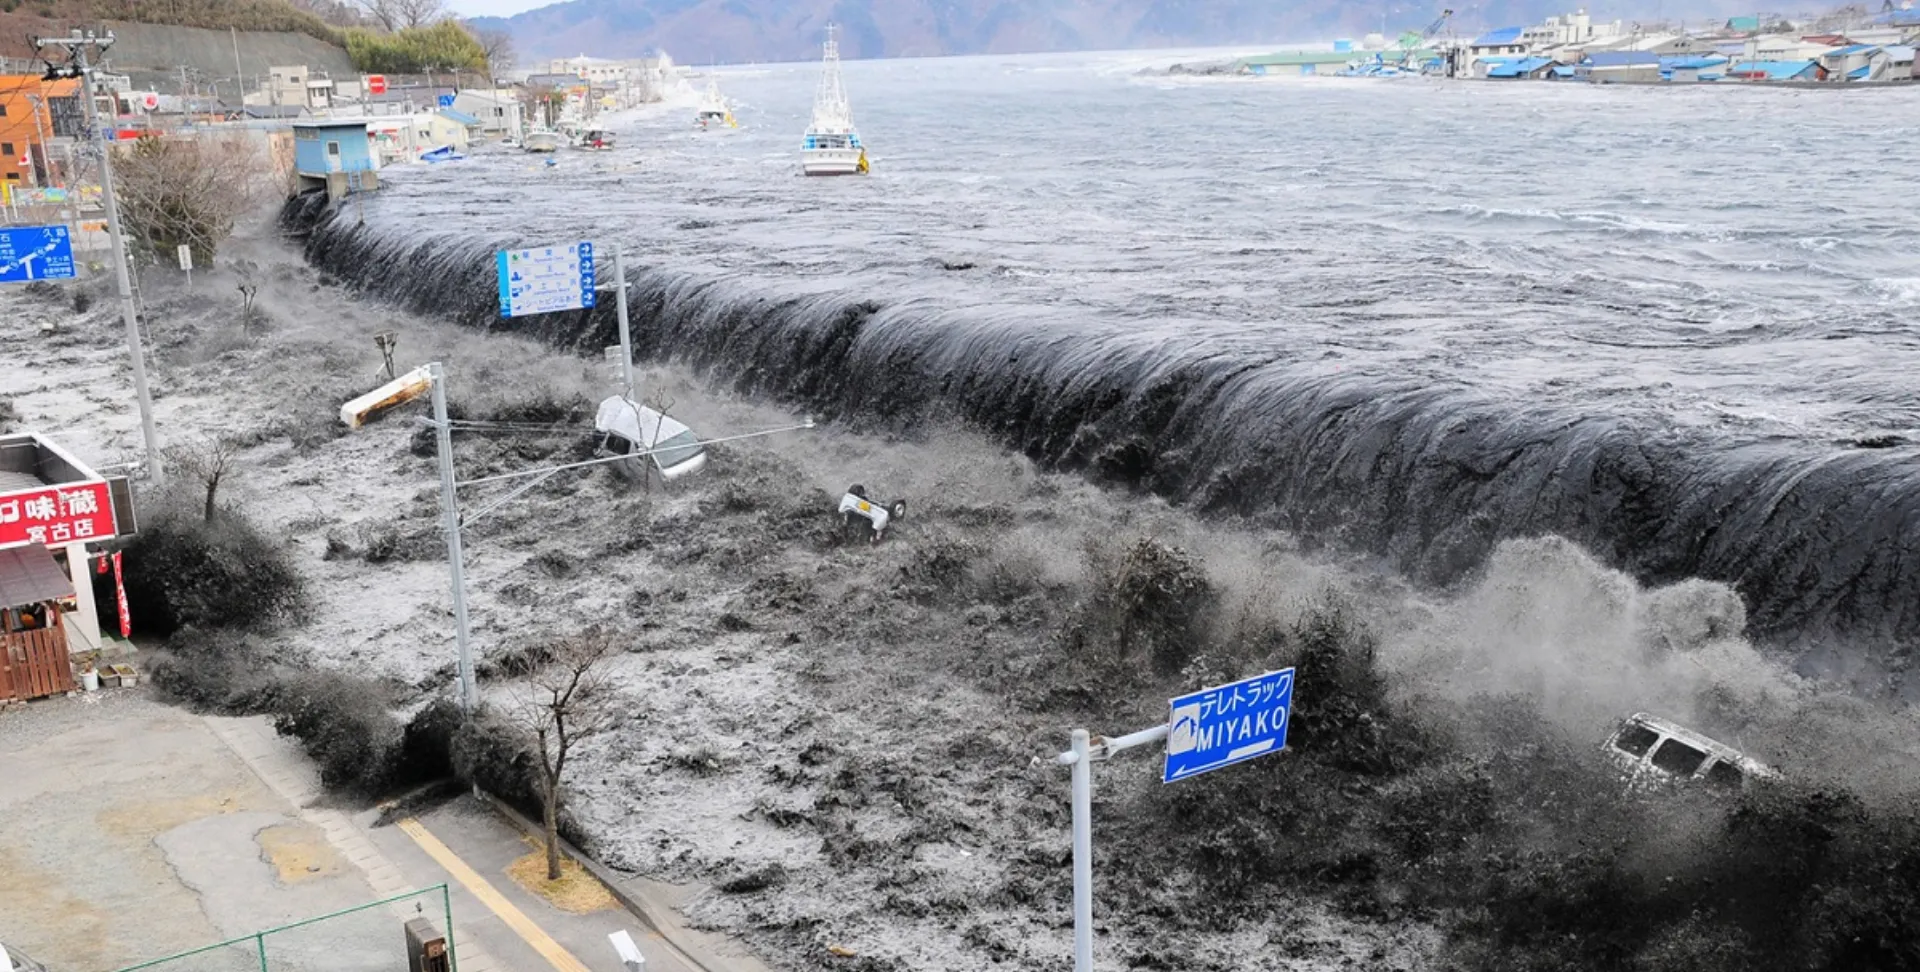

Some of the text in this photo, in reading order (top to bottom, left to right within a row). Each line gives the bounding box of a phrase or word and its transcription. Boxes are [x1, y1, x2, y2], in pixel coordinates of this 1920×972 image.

[1200, 673, 1291, 720] テレトラック
[1196, 705, 1286, 753] MIYAKO
